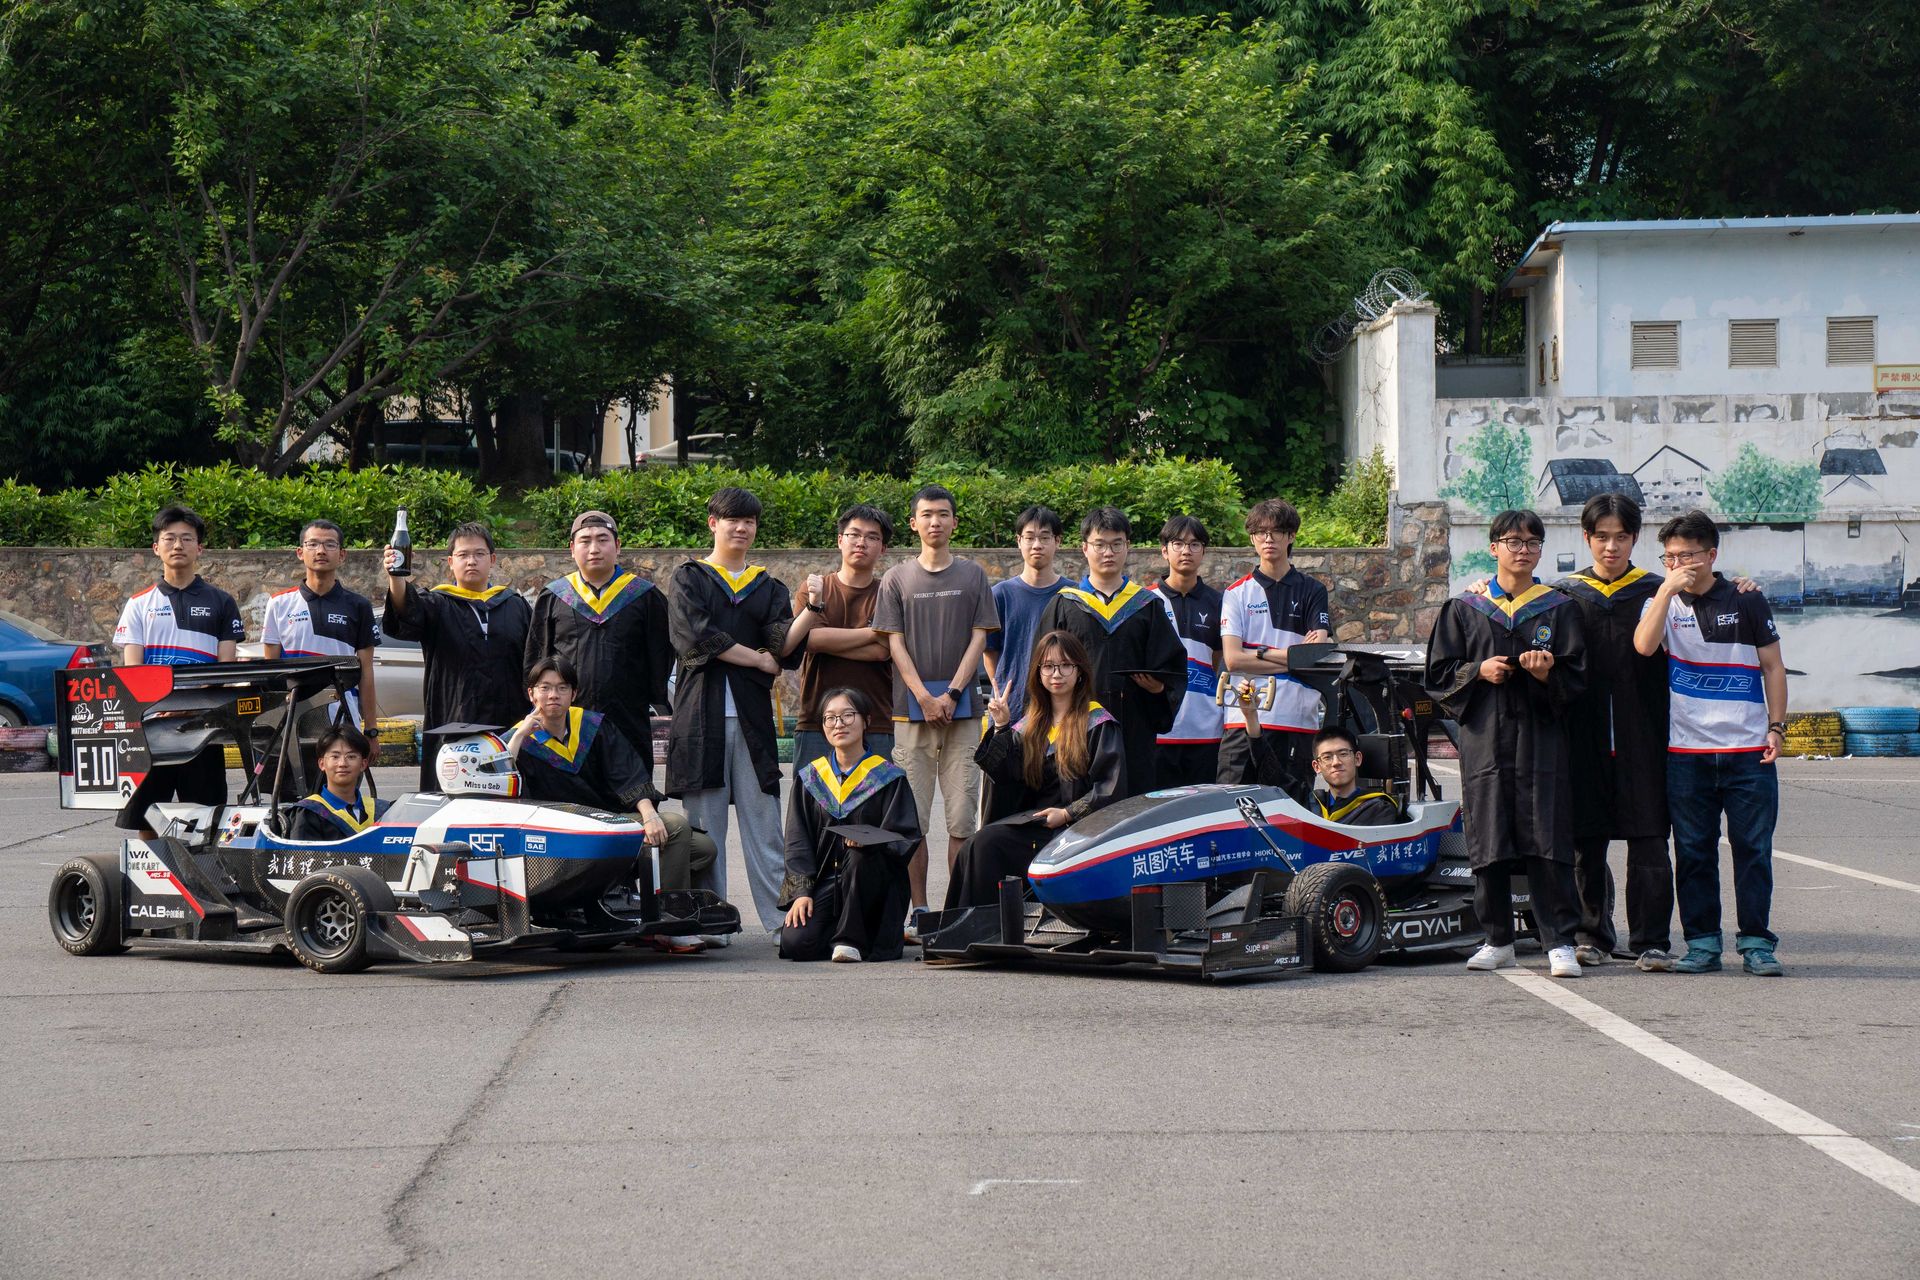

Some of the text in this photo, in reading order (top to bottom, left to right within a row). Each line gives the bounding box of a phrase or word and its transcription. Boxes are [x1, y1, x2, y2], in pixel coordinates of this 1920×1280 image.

[66, 677, 108, 703] ZGL
[76, 746, 115, 787] E10
[469, 833, 505, 852] RSC
[527, 842, 544, 850] SAE
[1132, 842, 1196, 879] 岚图汽车
[1254, 849, 1274, 858] HIOKI
[141, 862, 160, 871] KART
[129, 904, 166, 918] CALB
[1388, 915, 1461, 938] VOYAH
